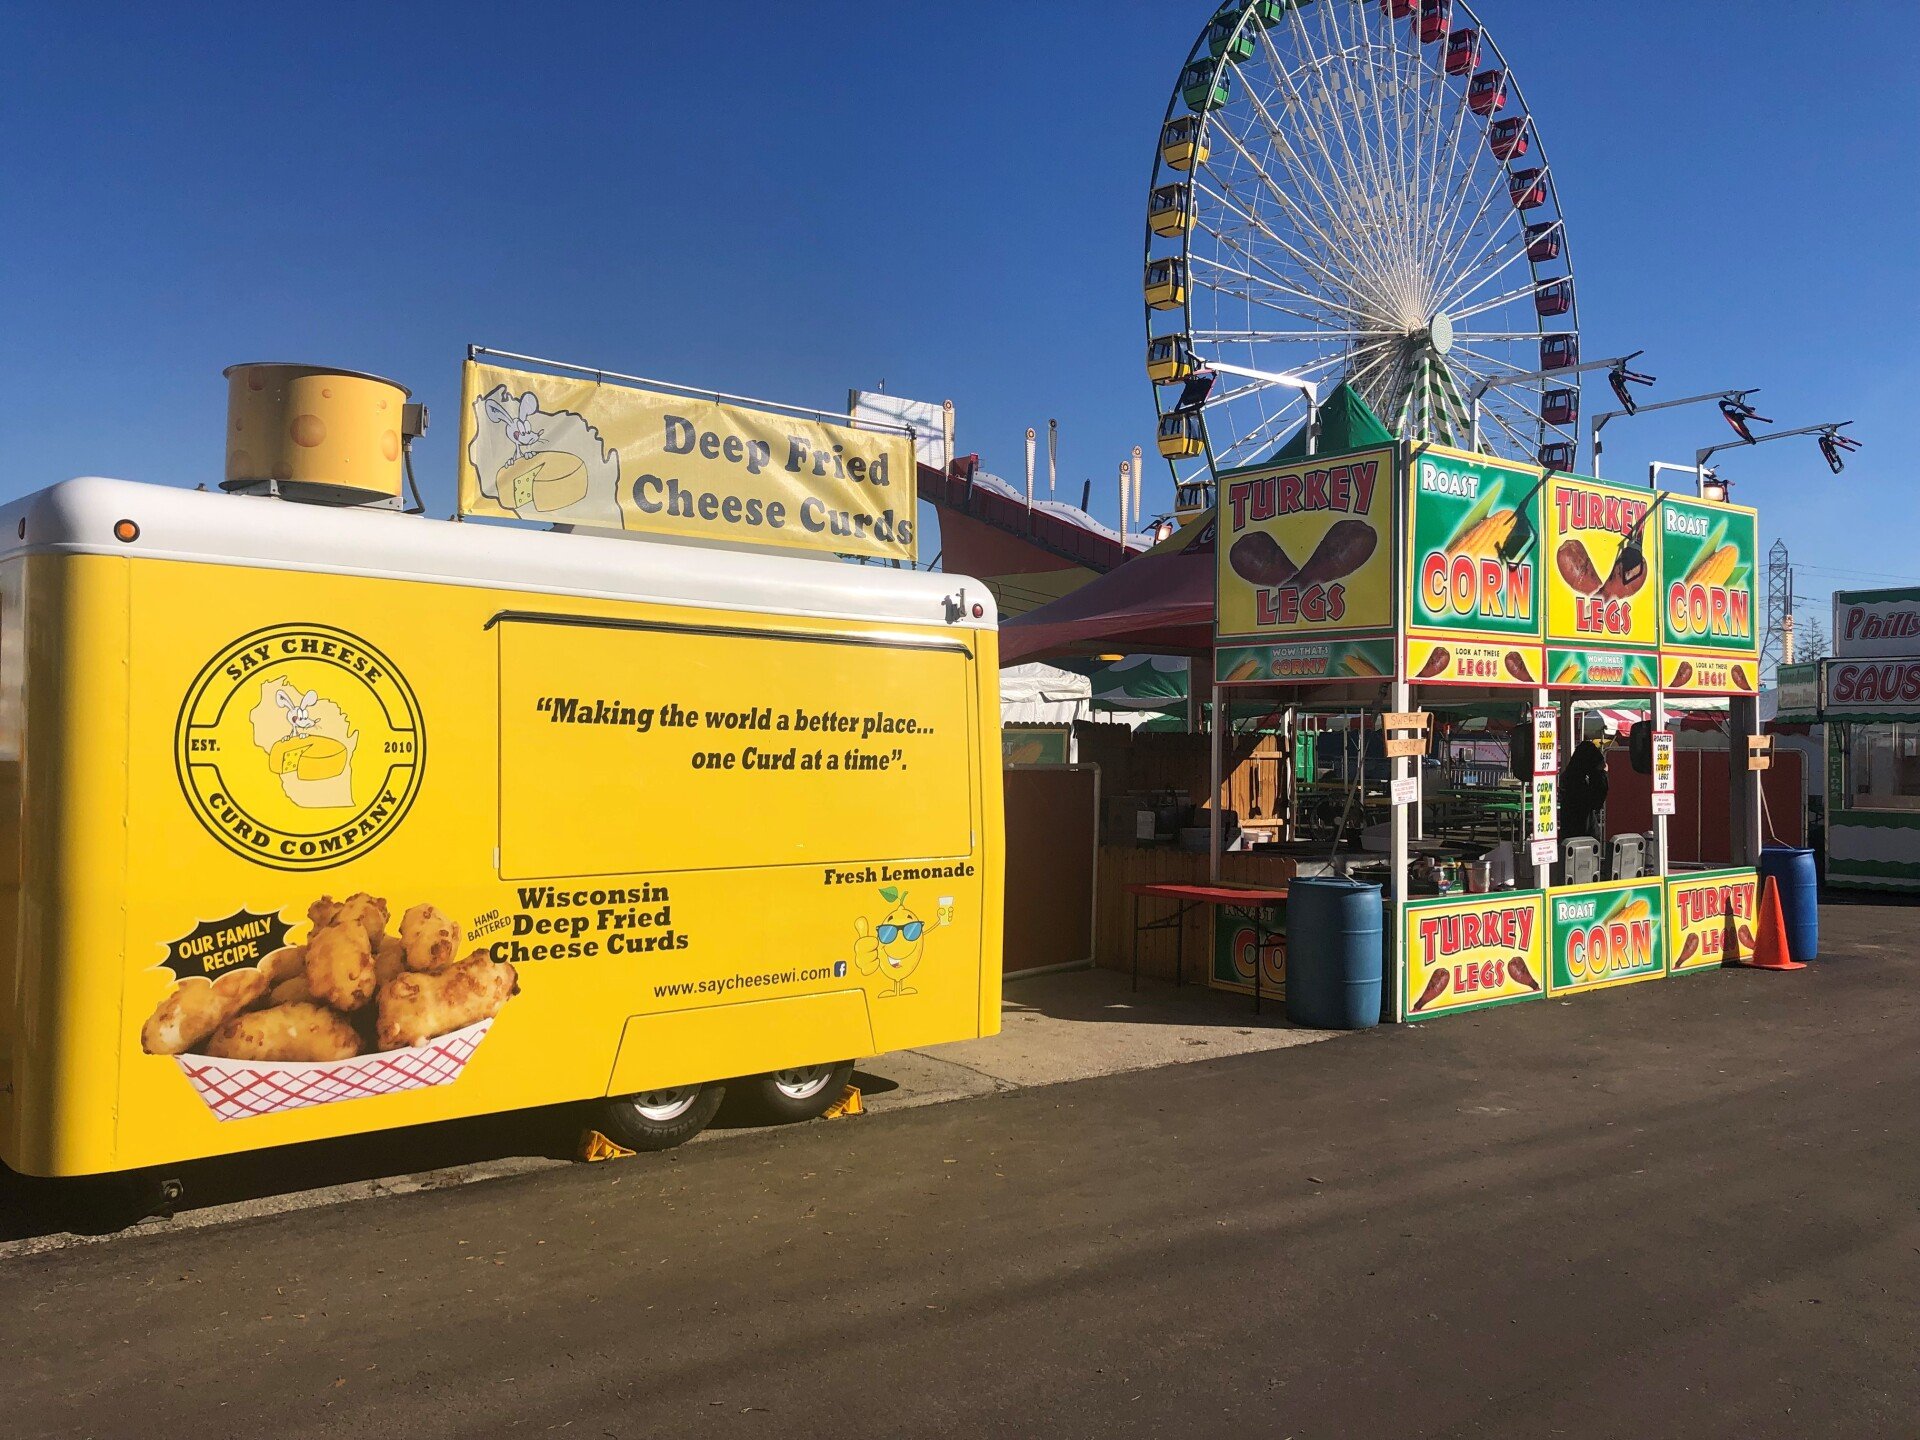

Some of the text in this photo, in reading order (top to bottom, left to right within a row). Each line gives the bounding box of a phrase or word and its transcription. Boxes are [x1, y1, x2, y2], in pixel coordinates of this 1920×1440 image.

[663, 414, 891, 487] Deep Fried
[1421, 462, 1479, 498] ROAST
[632, 473, 914, 545] Cheese Curds
[1229, 461, 1380, 533] TURKEY
[1555, 486, 1648, 543] TURKEY
[1665, 509, 1708, 537] ROAST
[1421, 551, 1532, 620] CORN
[1257, 583, 1346, 625] LEGS
[1575, 596, 1632, 635] LEGS
[1669, 581, 1750, 638] CORN
[226, 638, 383, 684] SAY CHEESE
[1272, 646, 1329, 656] WOW THAT'S
[1588, 655, 1603, 663] WOW
[1271, 657, 1328, 676] CORNY
[1457, 658, 1498, 677] LEGS!
[1588, 666, 1623, 682] CORNY
[1698, 670, 1727, 686] LEGS!
[659, 704, 699, 728] the
[705, 707, 771, 732] world
[776, 714, 790, 732] a
[794, 709, 859, 733] better
[861, 711, 935, 739] place...
[1535, 711, 1555, 719] ROASTED
[1539, 721, 1552, 729] CORN
[191, 739, 413, 753] EST. 2010
[691, 750, 735, 770] one
[741, 746, 795, 770] Curd
[800, 749, 823, 770] at
[826, 754, 839, 770] a
[1537, 742, 1555, 750] TURKEY
[1540, 752, 1552, 760] LEGS
[1657, 744, 1669, 752] CORN
[1537, 783, 1553, 792] CORN
[1539, 794, 1552, 804] IN A
[209, 790, 398, 855] CURD COMPANY
[1540, 806, 1551, 815] CUP
[1537, 822, 1554, 832] $5.00
[824, 862, 975, 885] Fresh Lemonade
[517, 882, 669, 910] Wisconsin
[1677, 882, 1755, 930] TURKEY
[474, 909, 499, 927] HAND
[512, 906, 671, 938] Deep Fried
[1557, 901, 1595, 921] ROAST
[178, 917, 272, 959] OUR FAMILY
[468, 916, 511, 941] BATTERED
[1420, 906, 1535, 966] TURKEY
[203, 941, 259, 972] RECIPE
[489, 930, 689, 964] Cheese Curds
[1566, 919, 1653, 978] CORN
[653, 964, 832, 998] www.saycheesewi.com
[1453, 958, 1506, 994] LEGS
